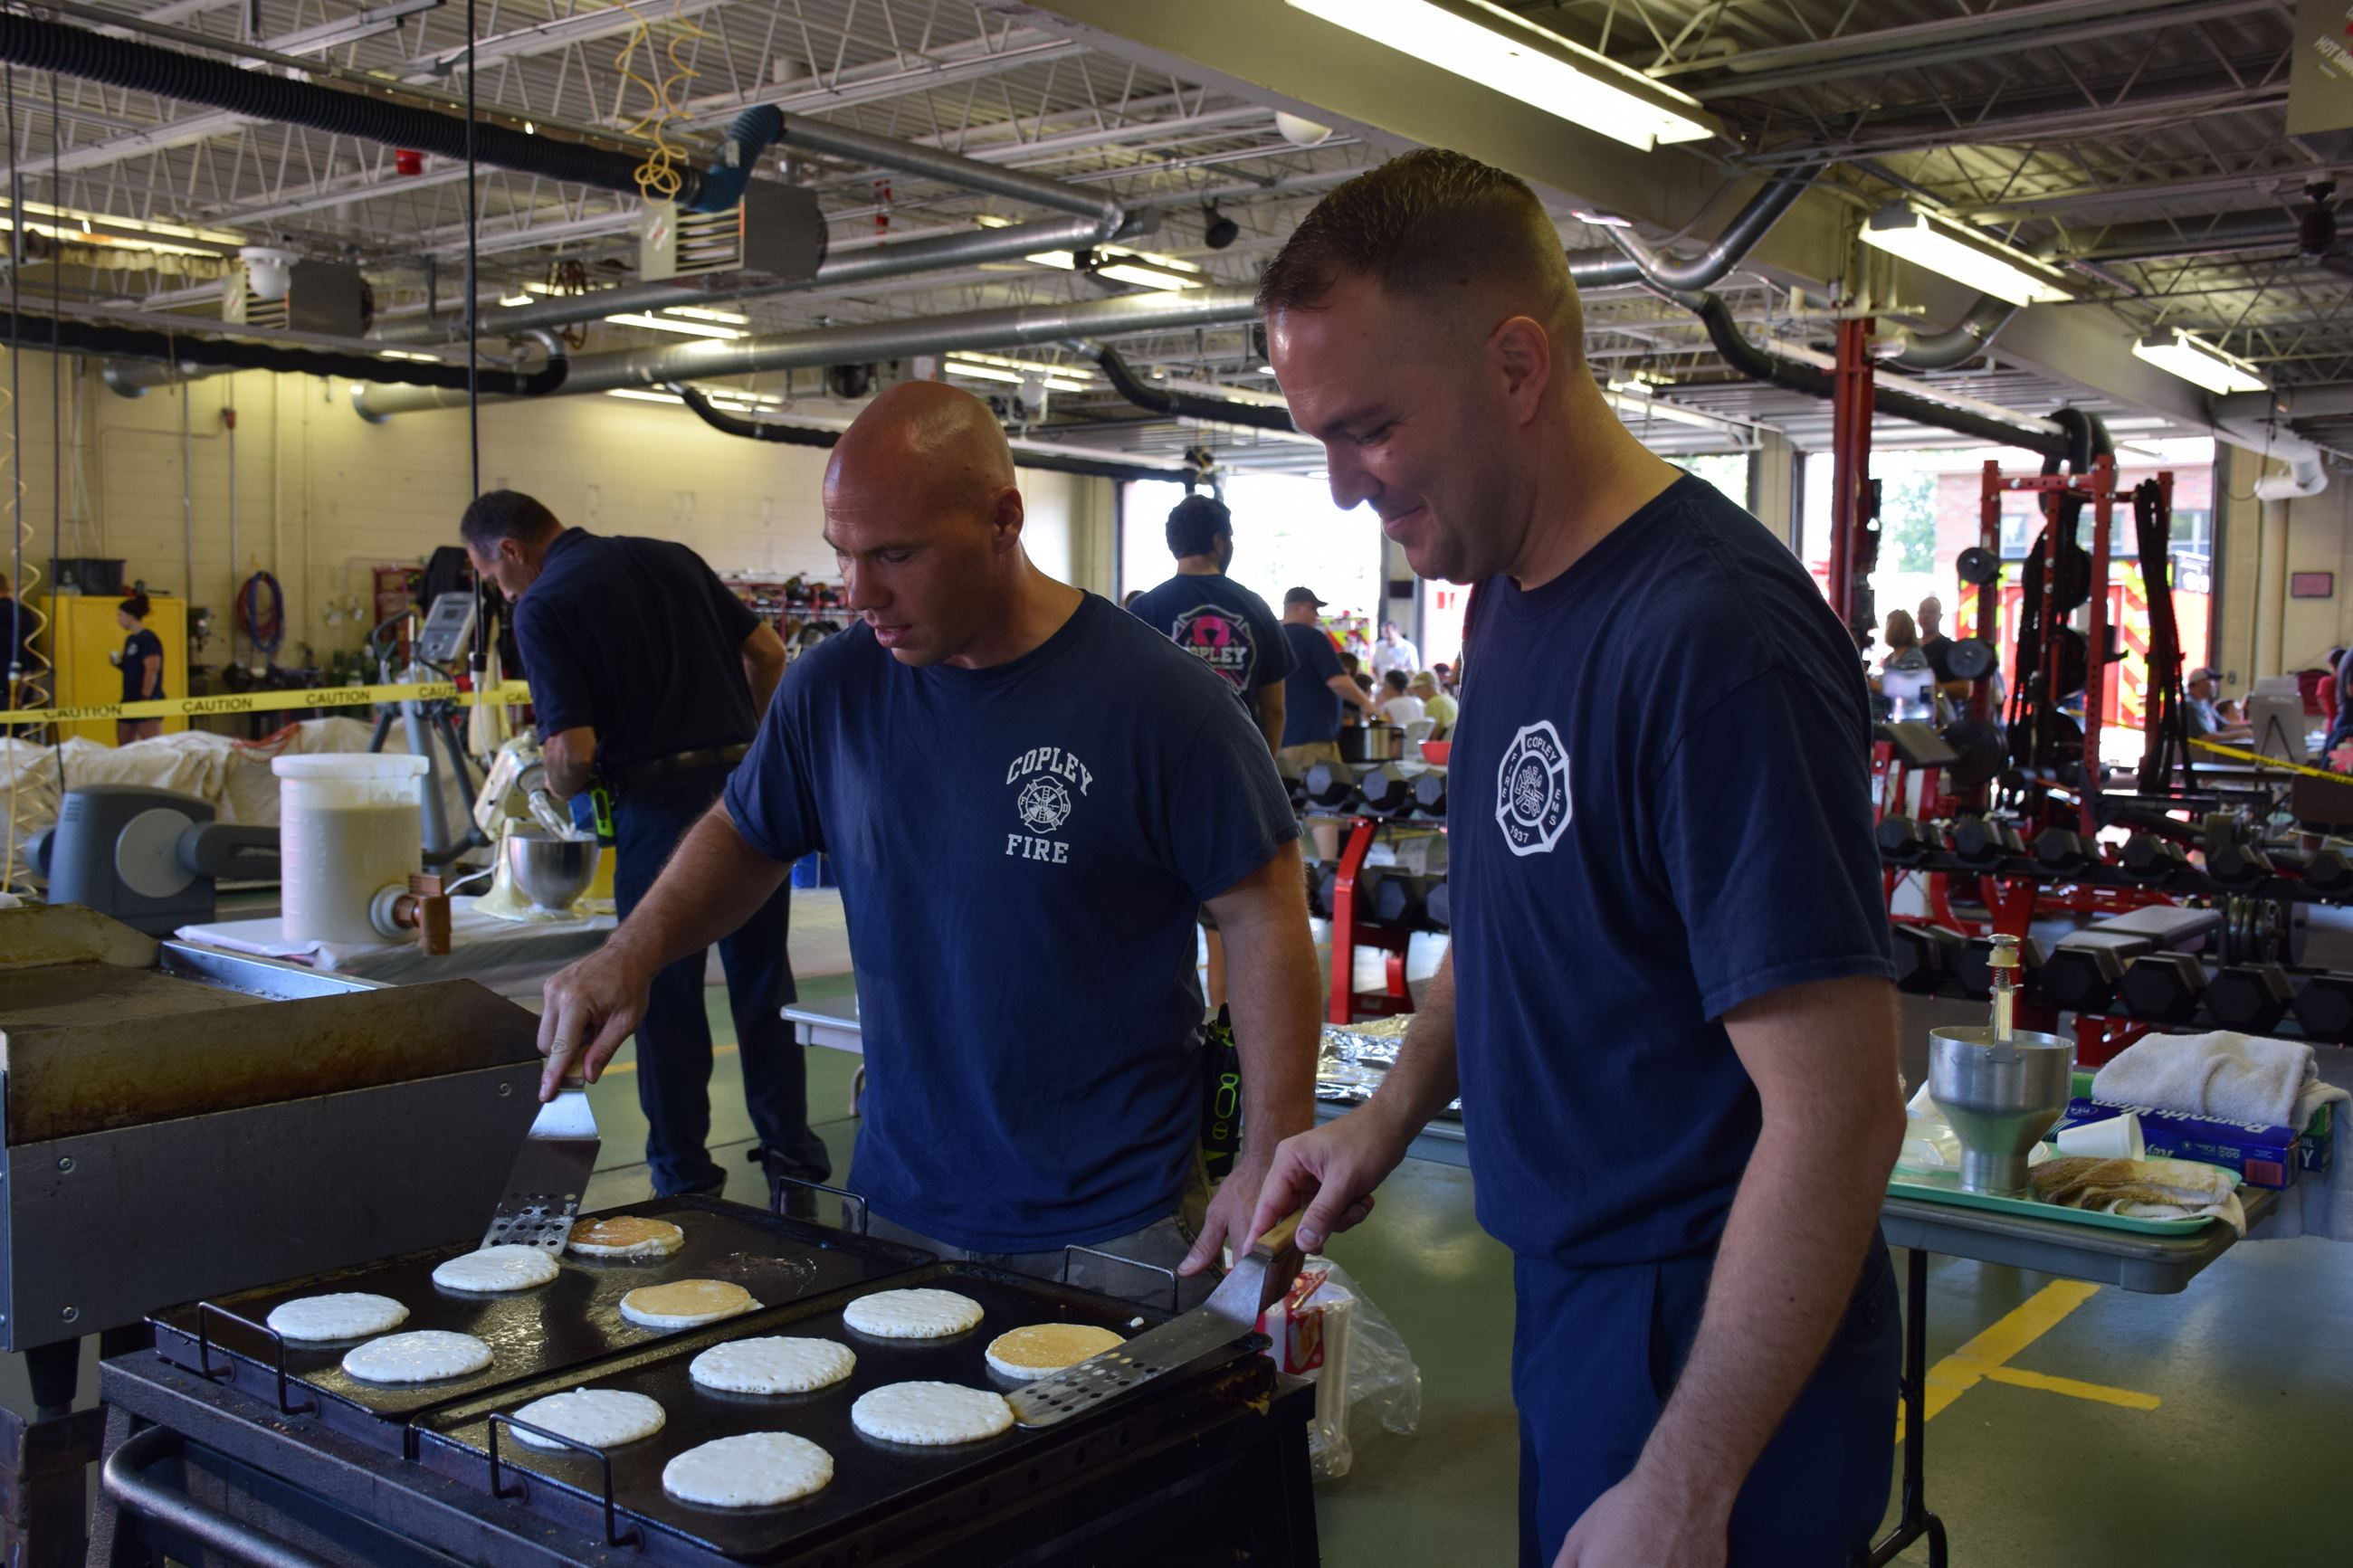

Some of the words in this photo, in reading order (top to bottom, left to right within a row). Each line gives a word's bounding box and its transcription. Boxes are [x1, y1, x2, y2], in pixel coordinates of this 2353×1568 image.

[2313, 34, 2341, 58] HOT
[182, 697, 253, 714] CAUTION
[306, 689, 371, 706] CAUTION
[1527, 736, 1558, 762] COPLEY
[1006, 746, 1093, 797] COPLEY
[1501, 752, 1518, 799] FIRE
[1548, 788, 1562, 826] EMS
[1510, 824, 1529, 843] 1937
[1005, 833, 1070, 864] FIRE
